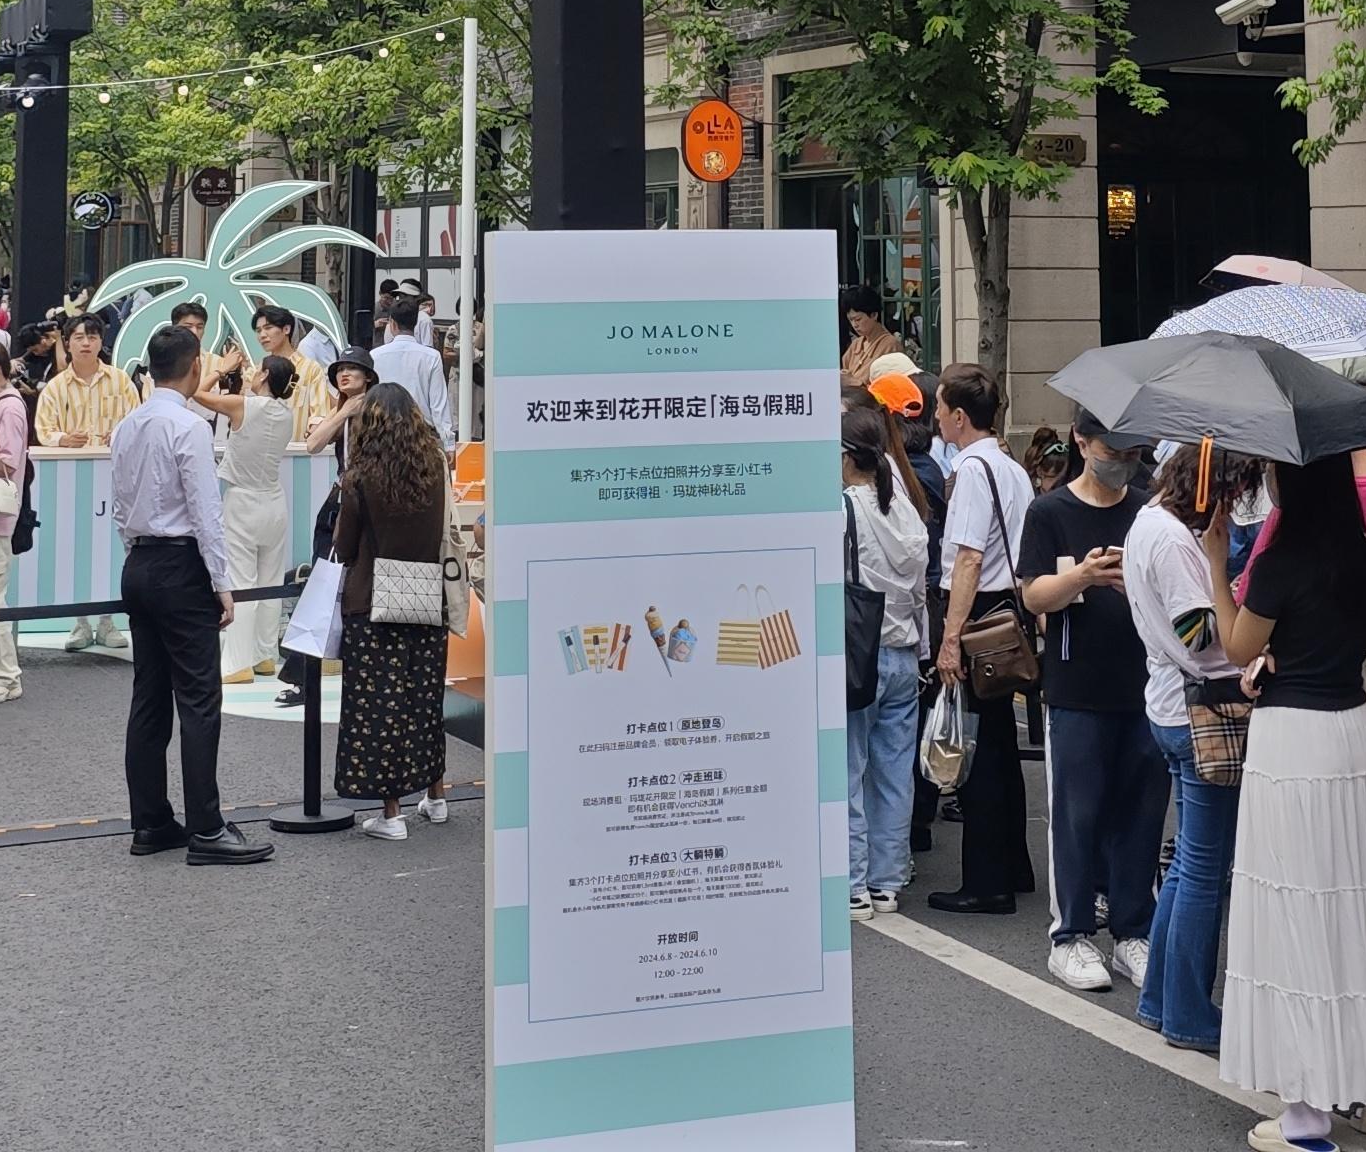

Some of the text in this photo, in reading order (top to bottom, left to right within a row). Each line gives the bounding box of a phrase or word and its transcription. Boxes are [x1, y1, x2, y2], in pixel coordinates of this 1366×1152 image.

[693, 114, 734, 134] OLLA
[607, 324, 734, 339] JO MALONE
[647, 347, 699, 356] LONDON
[526, 392, 814, 422] 欢迎来到花开限定「海岛假期」
[571, 463, 773, 483] 集齐3个打卡点位拍照并分享至小红书
[657, 930, 699, 945] 开放时间
[638, 952, 673, 964] 2024.6.8
[679, 947, 718, 960] 2024.6.10
[654, 969, 676, 979] 12:00
[682, 966, 704, 977] 22:00
